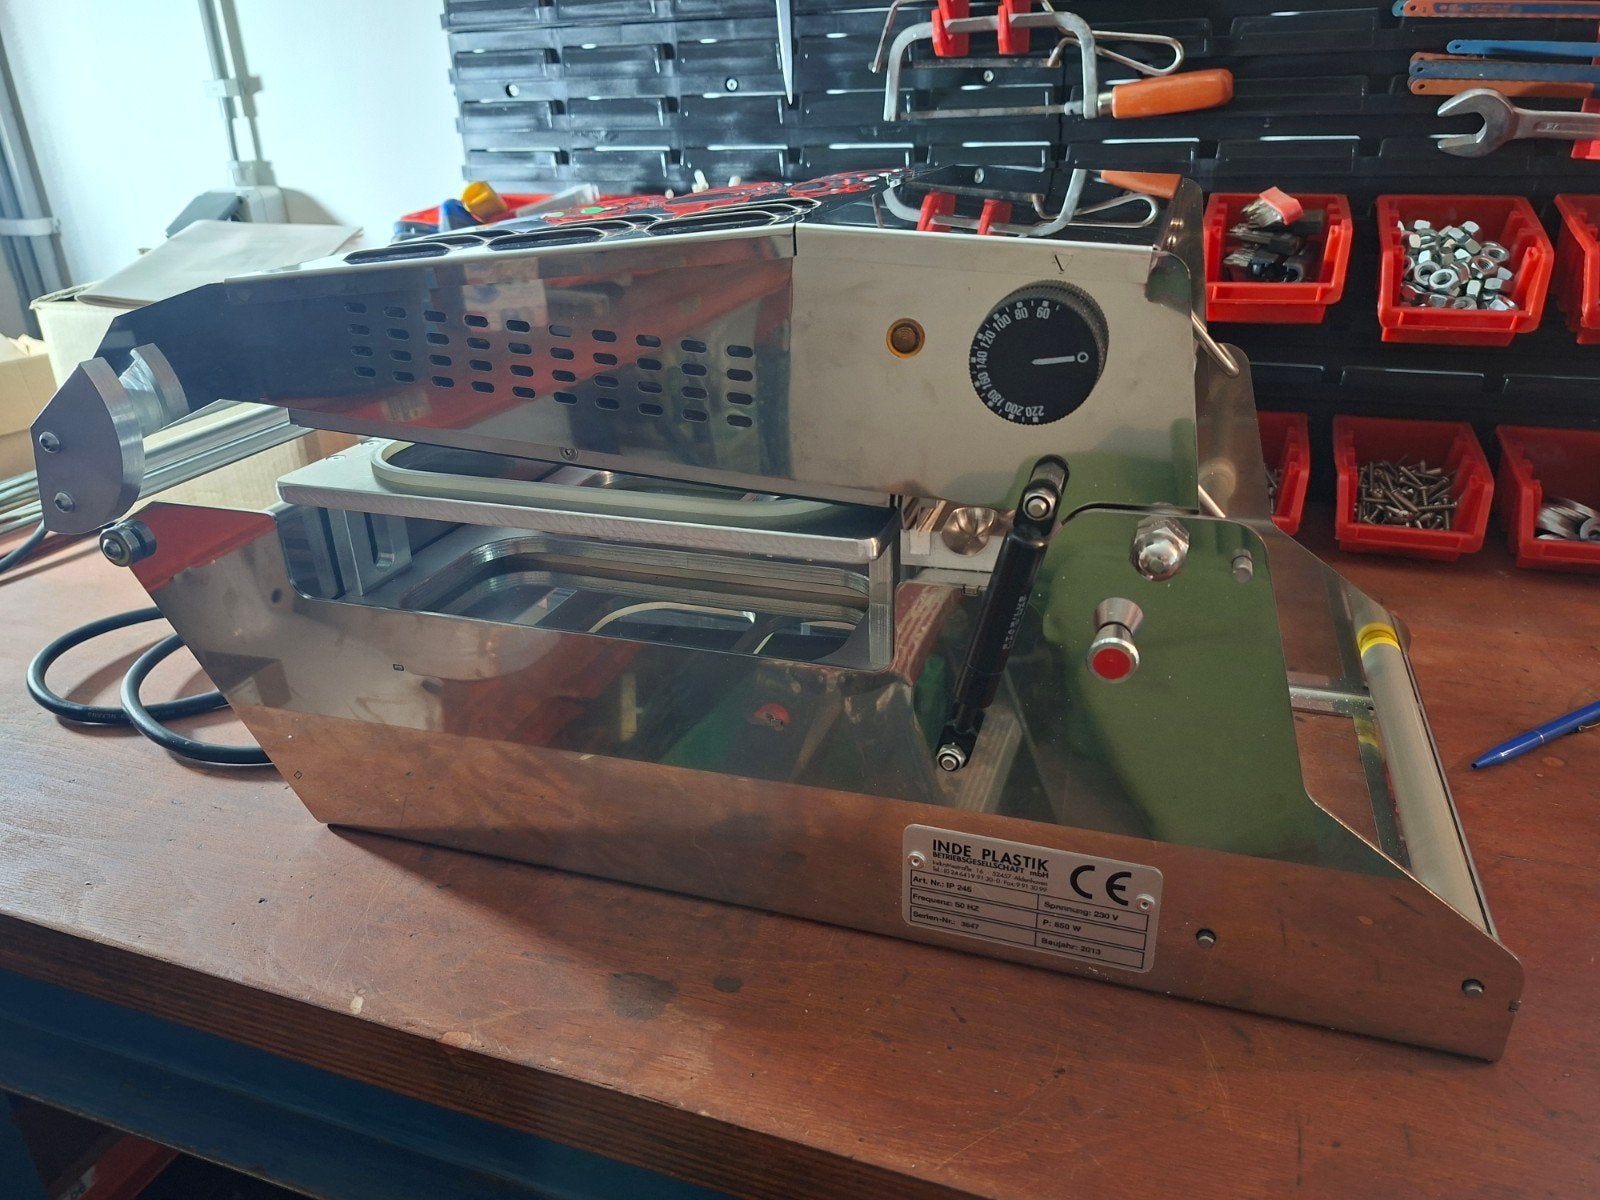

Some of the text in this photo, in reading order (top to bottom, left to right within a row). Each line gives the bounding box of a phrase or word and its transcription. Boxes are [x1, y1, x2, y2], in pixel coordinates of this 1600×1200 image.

[1014, 307, 1029, 320] 80
[1036, 306, 1051, 319] 60
[992, 314, 1012, 332] 100
[980, 330, 996, 349] 120
[976, 351, 988, 369] 140
[977, 371, 992, 390] 160
[987, 389, 1005, 407] 180
[1004, 401, 1024, 416] 200
[1025, 405, 1045, 417] 220
[932, 839, 1049, 871] INDE PLASTIK
[932, 851, 1048, 879] BETRIEBSGESELLSCHAFT mbH
[912, 875, 928, 884] Art.
[946, 881, 955, 889] IP
[1070, 864, 1132, 907] CE
[912, 892, 952, 908] Frequenz:
[954, 901, 965, 909] 50
[1093, 910, 1109, 919] 230
[1111, 913, 1118, 921] V
[1042, 918, 1051, 927] P:
[1072, 924, 1081, 932] W
[1041, 937, 1078, 952] Baujahr:
